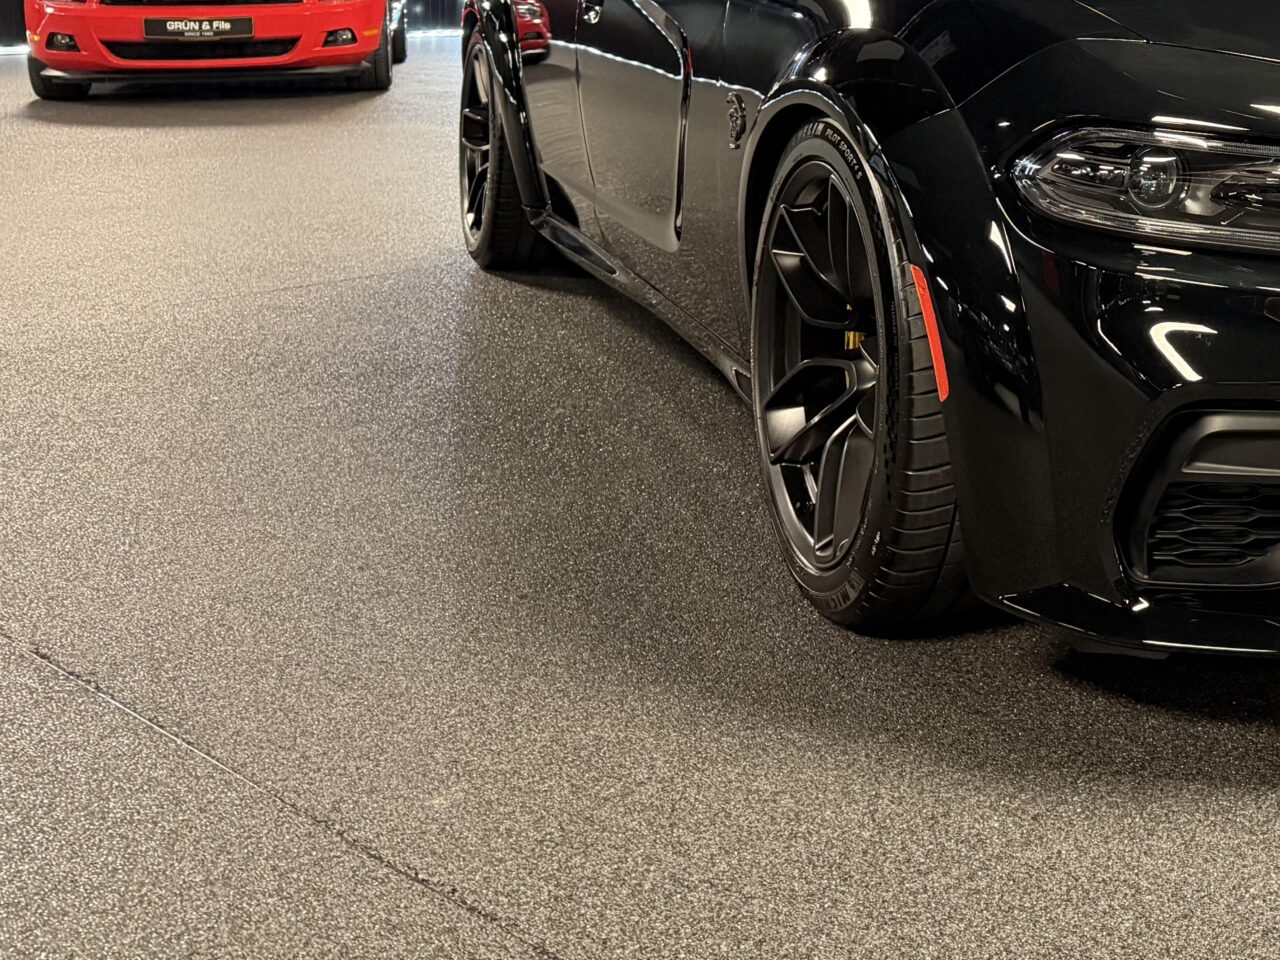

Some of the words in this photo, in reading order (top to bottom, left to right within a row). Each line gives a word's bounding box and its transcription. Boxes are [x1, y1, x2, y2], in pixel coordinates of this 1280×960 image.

[166, 20, 199, 31] GRÜN
[201, 21, 211, 30] &
[839, 140, 857, 167] SPORT
